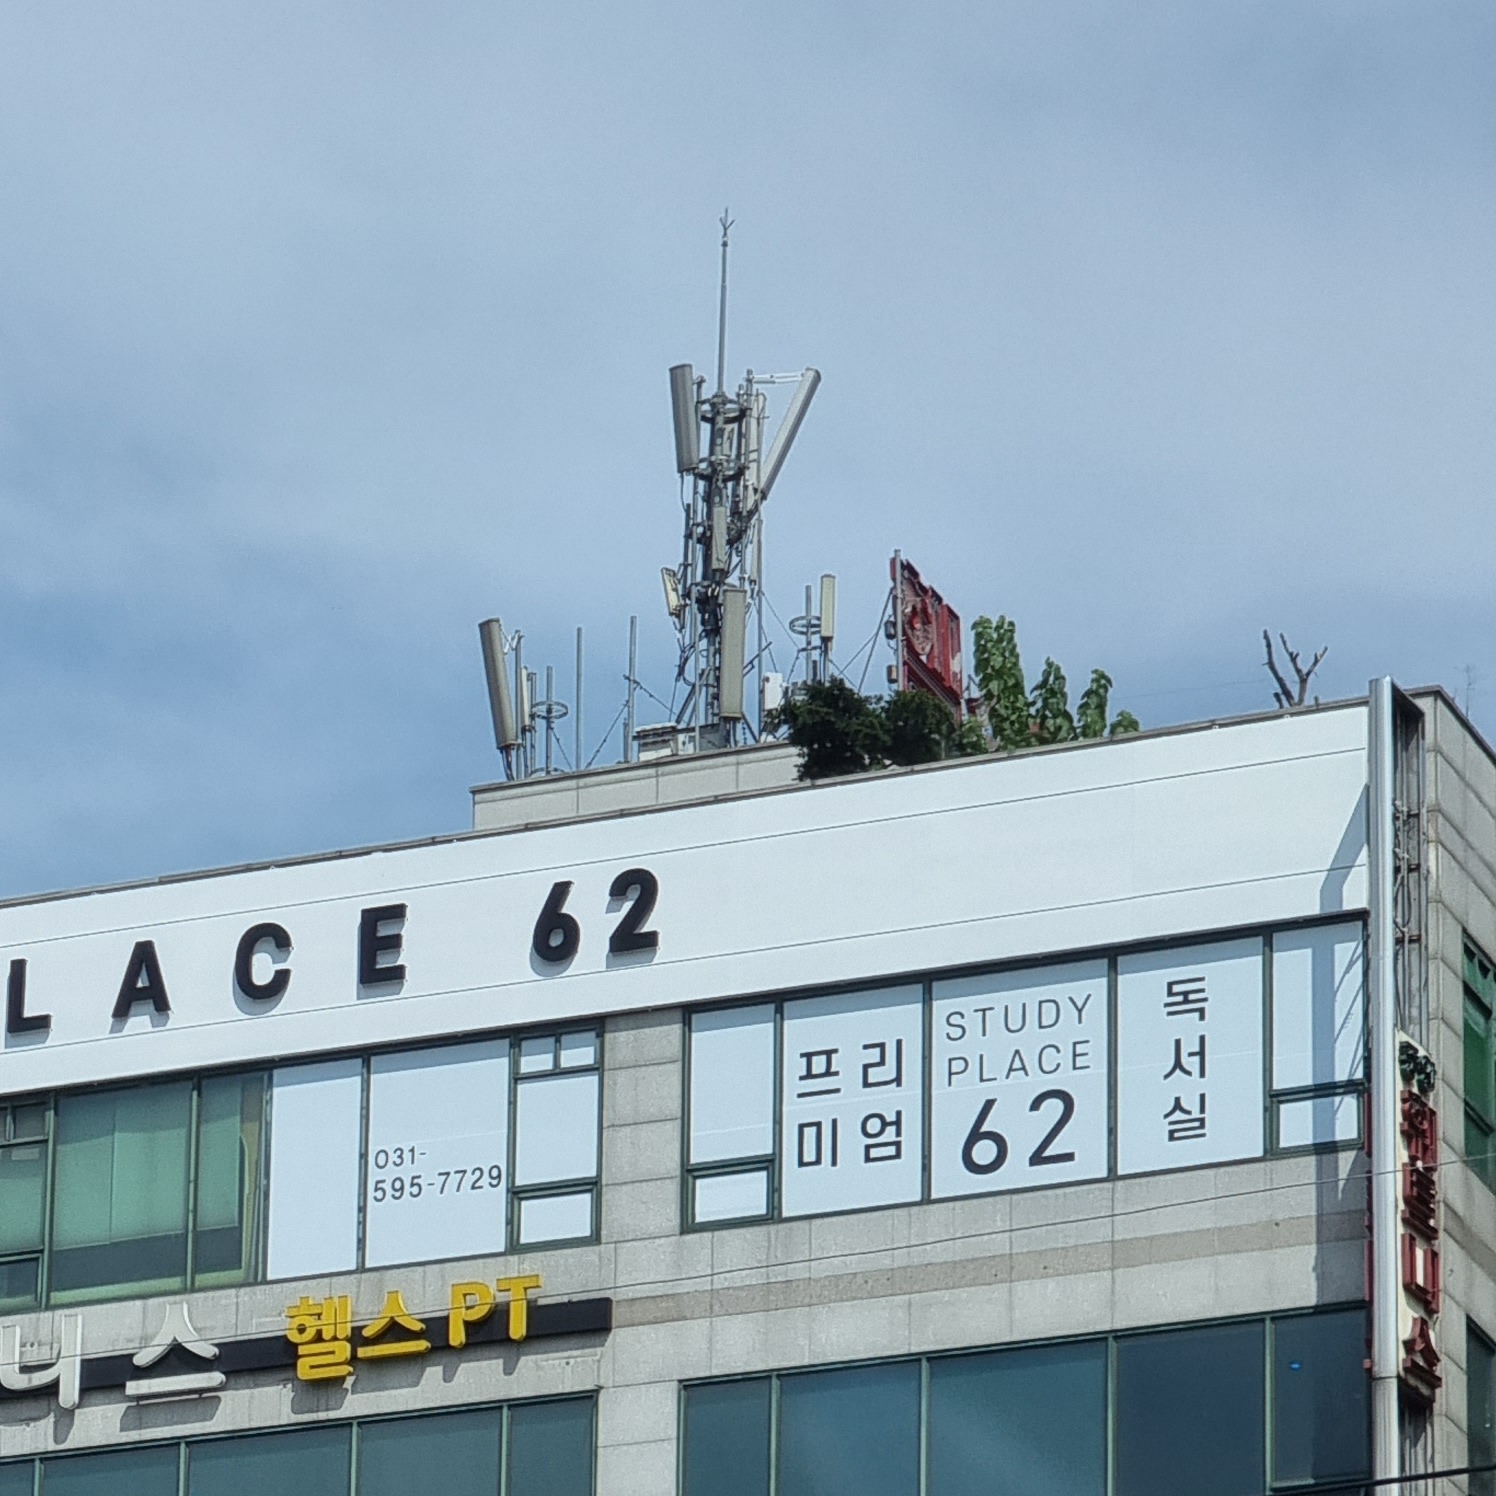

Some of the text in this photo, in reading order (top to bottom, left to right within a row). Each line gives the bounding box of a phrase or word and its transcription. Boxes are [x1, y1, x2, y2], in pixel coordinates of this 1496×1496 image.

[532, 867, 660, 963] 62
[945, 993, 1092, 1042] STUDY
[946, 1039, 1092, 1088] PLACE
[1162, 975, 1210, 1143] 독서실
[961, 1088, 1076, 1176] 62
[373, 1145, 427, 1170] 031-
[372, 1165, 503, 1203] 595-7729
